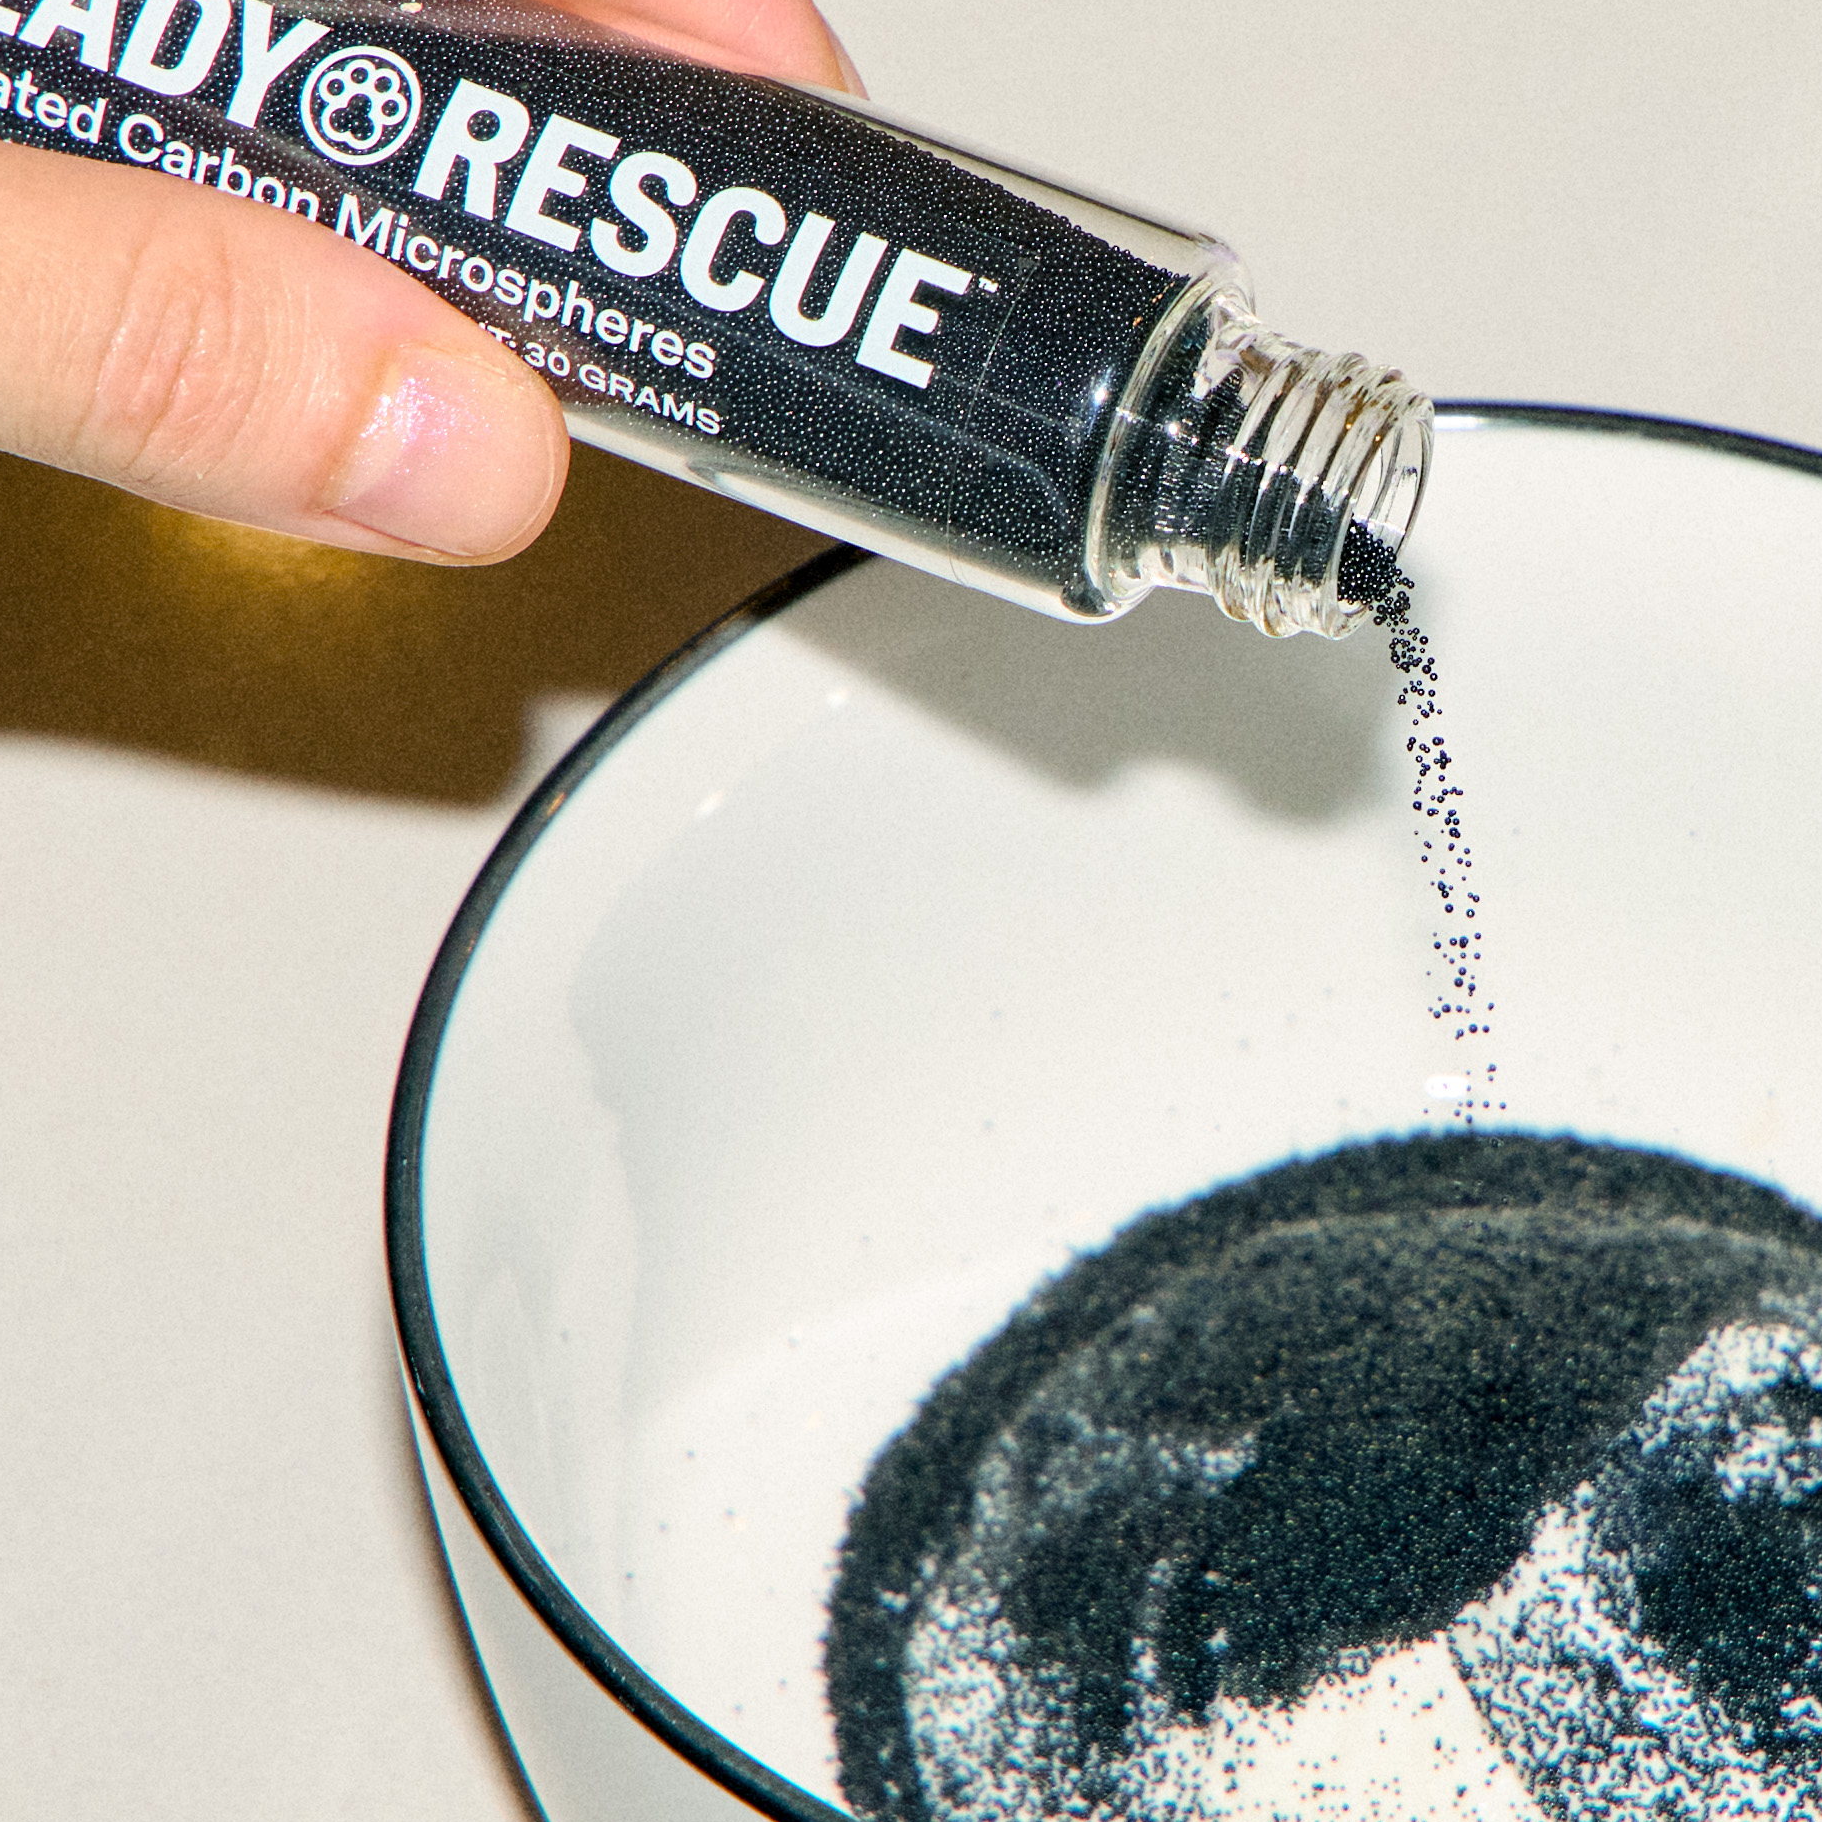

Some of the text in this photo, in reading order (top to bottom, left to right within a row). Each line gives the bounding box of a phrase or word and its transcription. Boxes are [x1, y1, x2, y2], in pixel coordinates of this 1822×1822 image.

[117, 112, 321, 223] Carbon
[335, 193, 717, 380] Microspheres
[524, 338, 721, 436] 30 GRAMS
